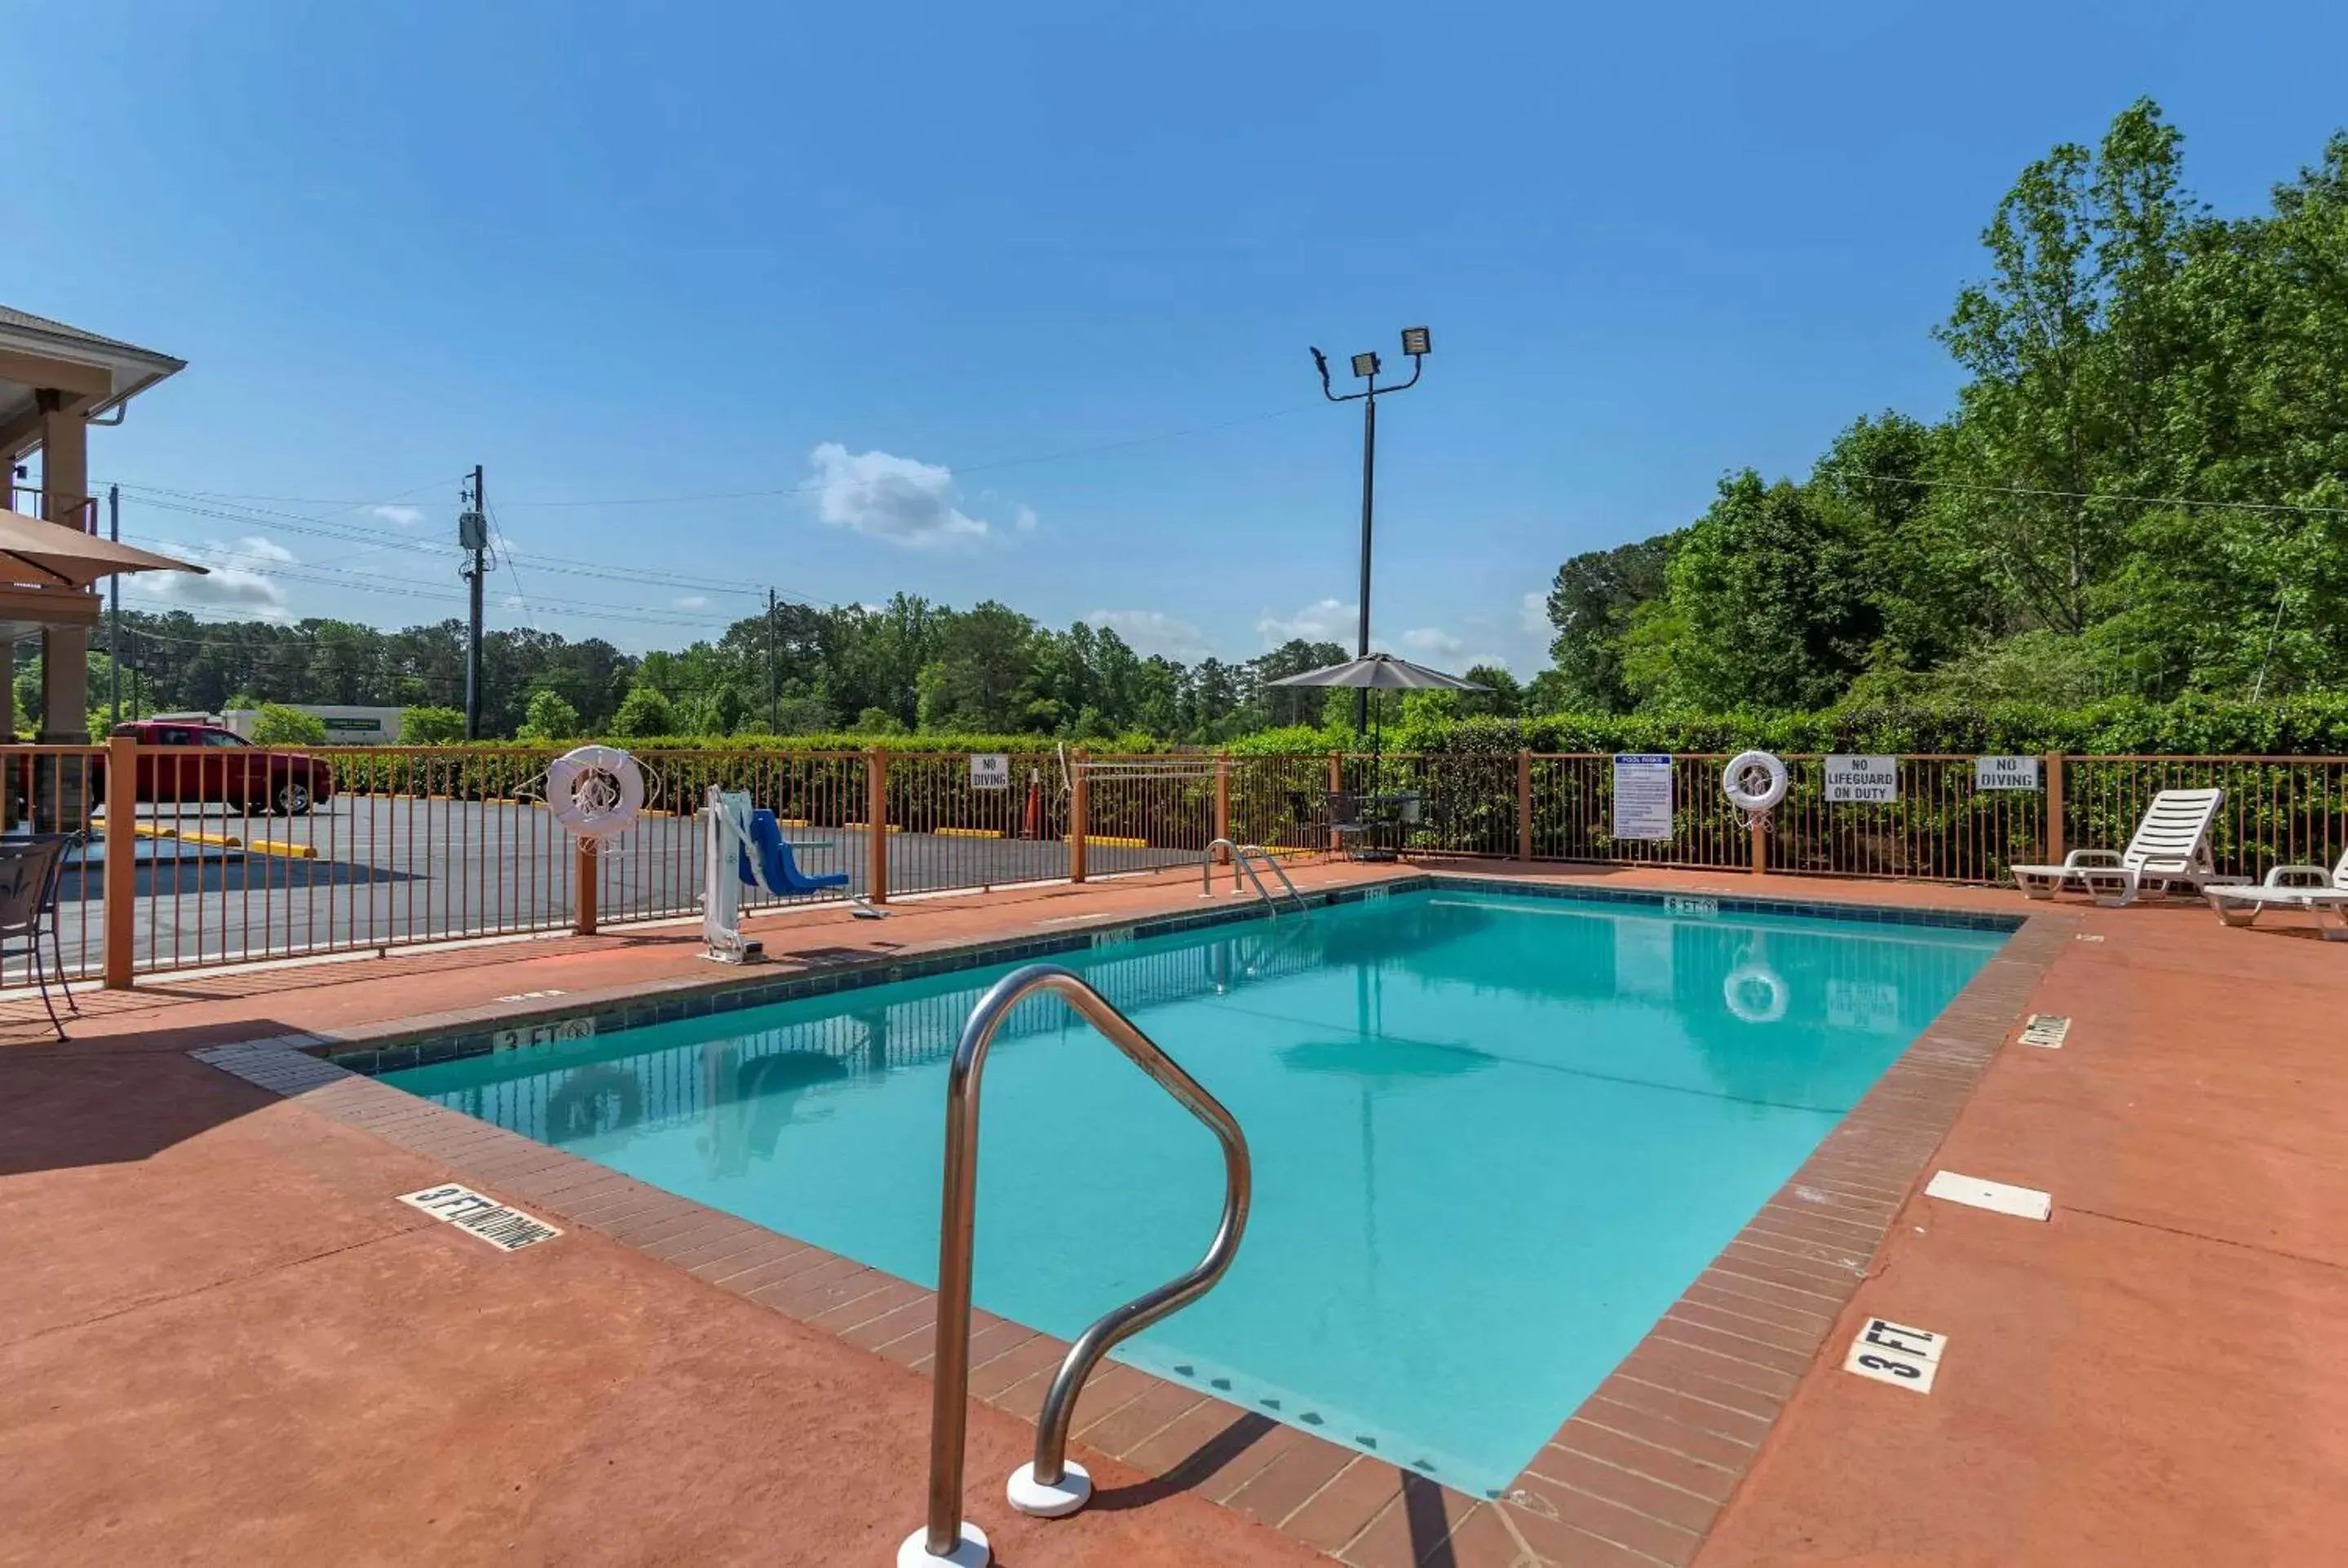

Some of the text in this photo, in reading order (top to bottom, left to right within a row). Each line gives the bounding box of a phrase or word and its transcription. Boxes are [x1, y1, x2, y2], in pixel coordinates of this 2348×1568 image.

[983, 758, 996, 770] NO
[1851, 759, 1868, 770] NO
[1996, 759, 2017, 771] NO
[973, 774, 1006, 785] DIVING
[1828, 774, 1893, 784] LIFEGUARD
[1981, 774, 2032, 786] DIVING
[1835, 787, 1886, 798] ON DUTY
[415, 1188, 460, 1202] 3
[1859, 1354, 1921, 1378] 3
